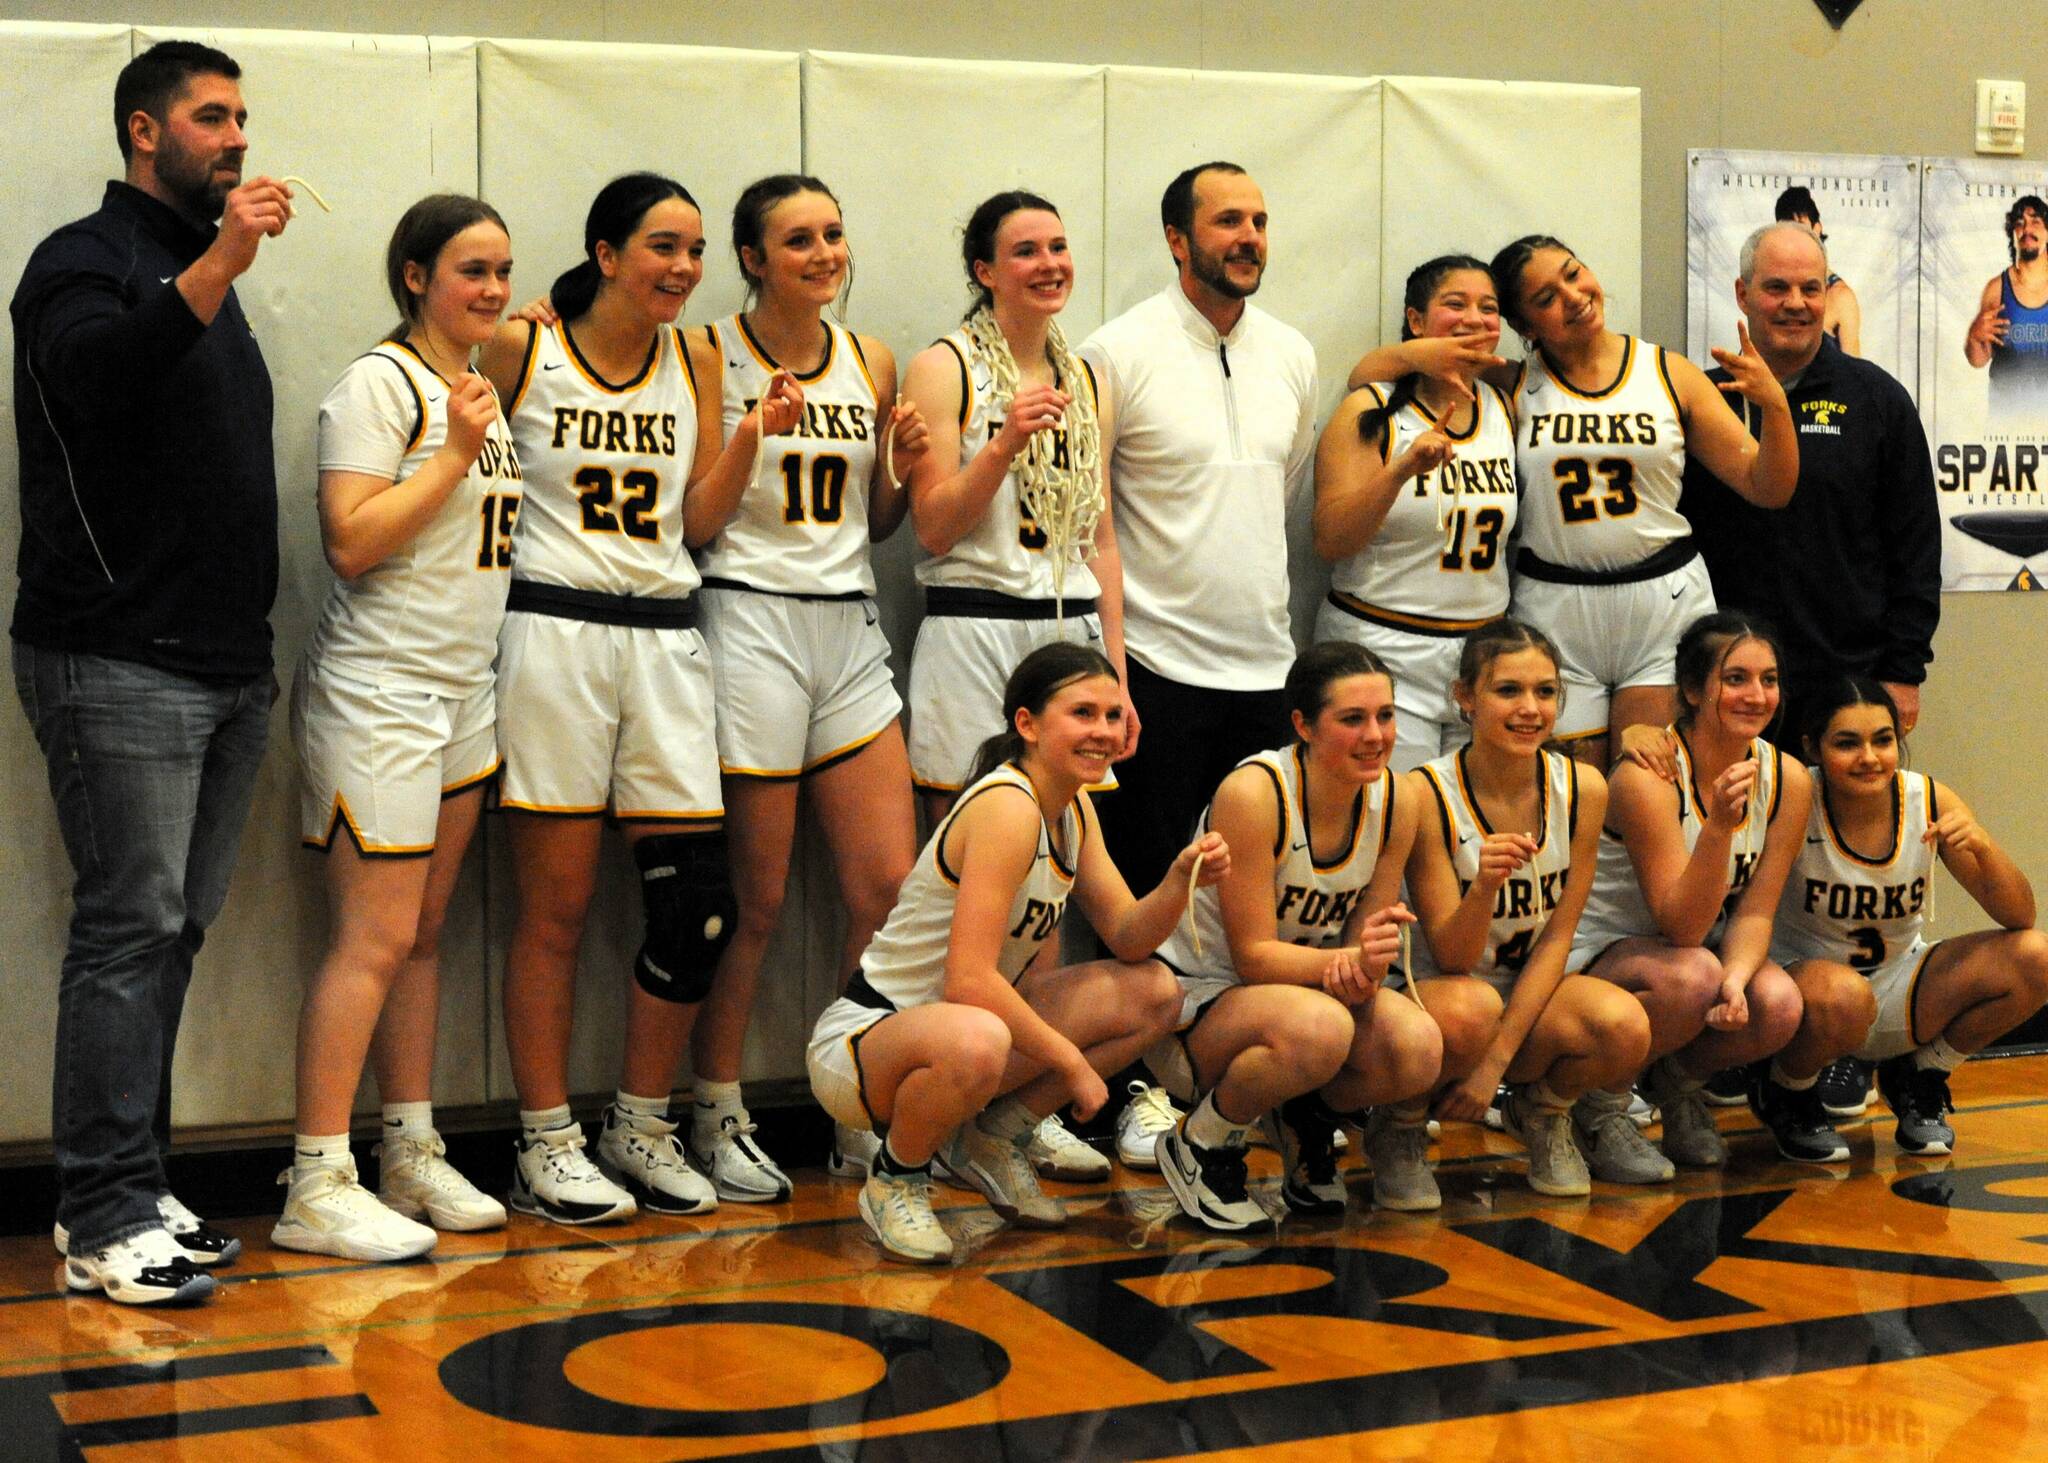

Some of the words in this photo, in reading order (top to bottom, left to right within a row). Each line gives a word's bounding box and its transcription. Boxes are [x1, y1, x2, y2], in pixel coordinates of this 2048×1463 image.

[1997, 114, 2017, 125] FIRE
[1722, 173, 1793, 188] WALKER
[1810, 176, 1889, 193] RONDEAU
[743, 398, 868, 441] RKS
[1801, 400, 1848, 414] FORKS
[551, 407, 677, 456] FORKS
[1529, 413, 1657, 448] FORKS
[1800, 424, 1841, 435] BASKETBALL
[574, 464, 660, 544] 22
[780, 451, 850, 526] 10
[1552, 456, 1639, 526] 23
[476, 494, 522, 571] 15
[1439, 506, 1508, 573] 13
[1804, 876, 1926, 920] FORKS
